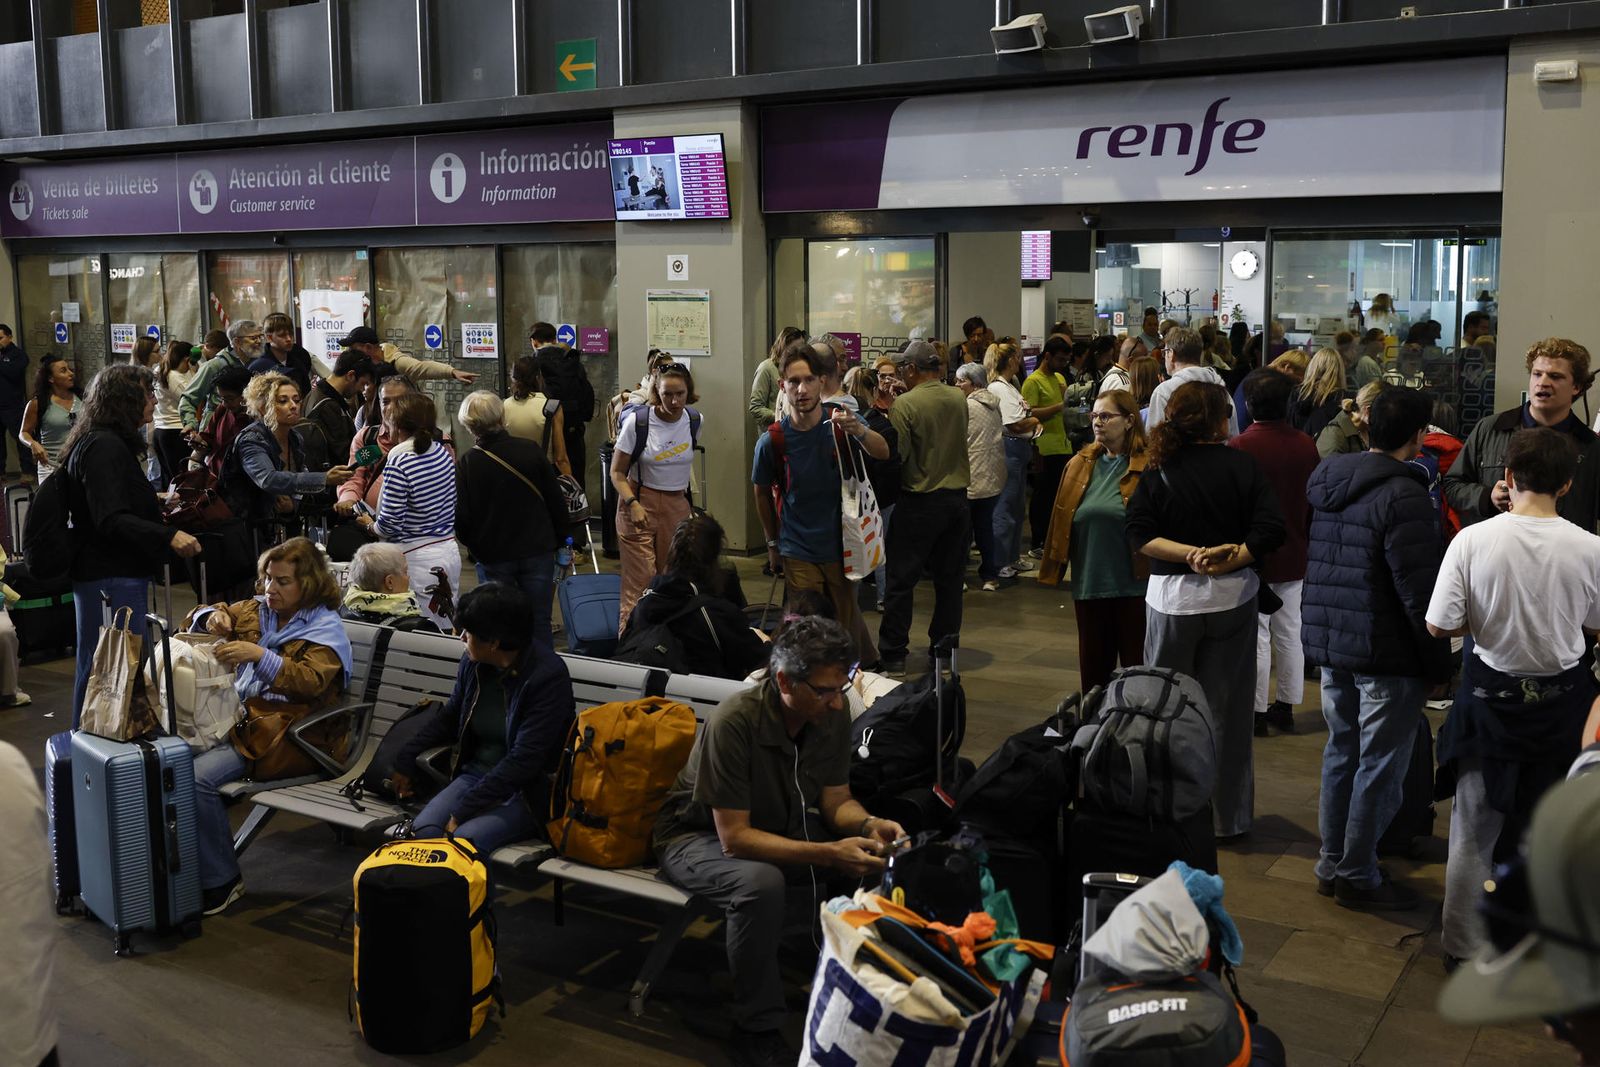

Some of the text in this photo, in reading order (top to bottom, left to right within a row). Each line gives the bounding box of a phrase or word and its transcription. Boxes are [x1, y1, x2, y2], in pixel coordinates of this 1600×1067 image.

[1076, 97, 1266, 176] renfe
[480, 142, 607, 175] Información
[229, 159, 391, 189] Atención al cliente
[42, 174, 158, 199] Venta de billetes
[481, 183, 556, 206] Information
[230, 195, 316, 213] Customer service
[42, 206, 89, 221] Tickets sale
[1221, 226, 1231, 238] 9
[306, 316, 345, 330] elecnor
[1115, 313, 1123, 324] 8
[1221, 314, 1229, 325] 9
[388, 850, 428, 859] NORTH
[410, 847, 430, 855] THE
[1107, 998, 1188, 1025] BASIC-FIT
